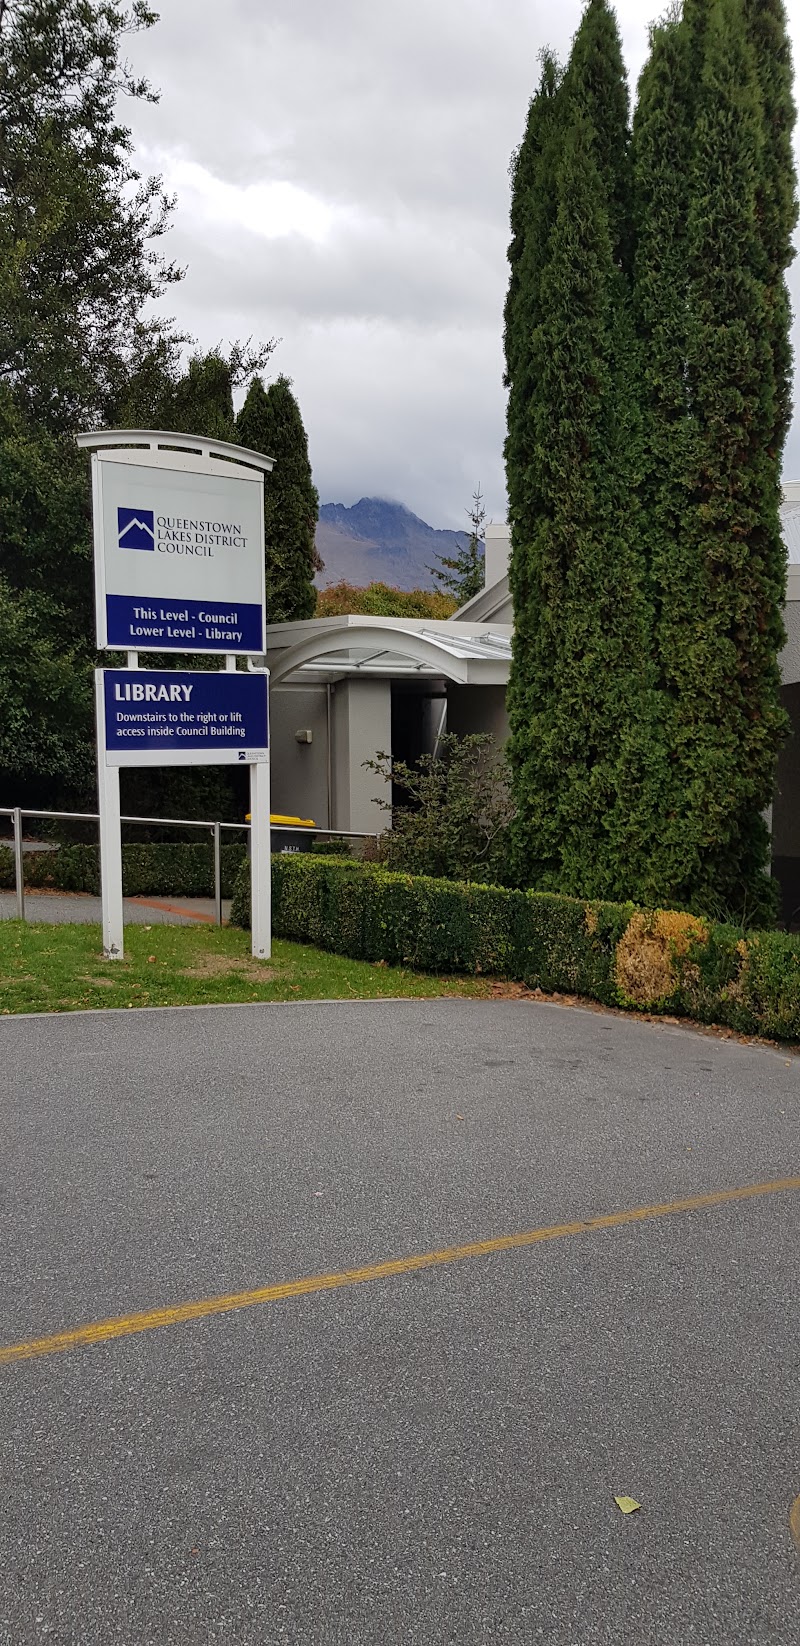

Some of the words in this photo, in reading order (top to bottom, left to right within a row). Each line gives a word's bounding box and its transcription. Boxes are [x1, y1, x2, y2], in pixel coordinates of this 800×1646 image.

[156, 516, 241, 535] QUEENSTOWN
[157, 529, 191, 543] LAKES
[195, 533, 248, 548] DISTRICT
[157, 542, 214, 557] COUNCIL
[133, 607, 157, 619] This
[160, 609, 188, 621] Level
[198, 612, 238, 624] Council
[130, 624, 164, 636] Lower
[167, 626, 195, 638] Level
[205, 628, 243, 642] Library
[115, 683, 193, 701] LIBRARY
[116, 712, 167, 722] Downstairs
[169, 713, 178, 722] to
[180, 712, 195, 722] the
[196, 712, 217, 724] right
[218, 714, 228, 722] or
[230, 712, 242, 722] lift
[116, 727, 146, 736] access
[147, 726, 174, 736] inside
[176, 726, 208, 736] Council
[210, 726, 246, 737] Building
